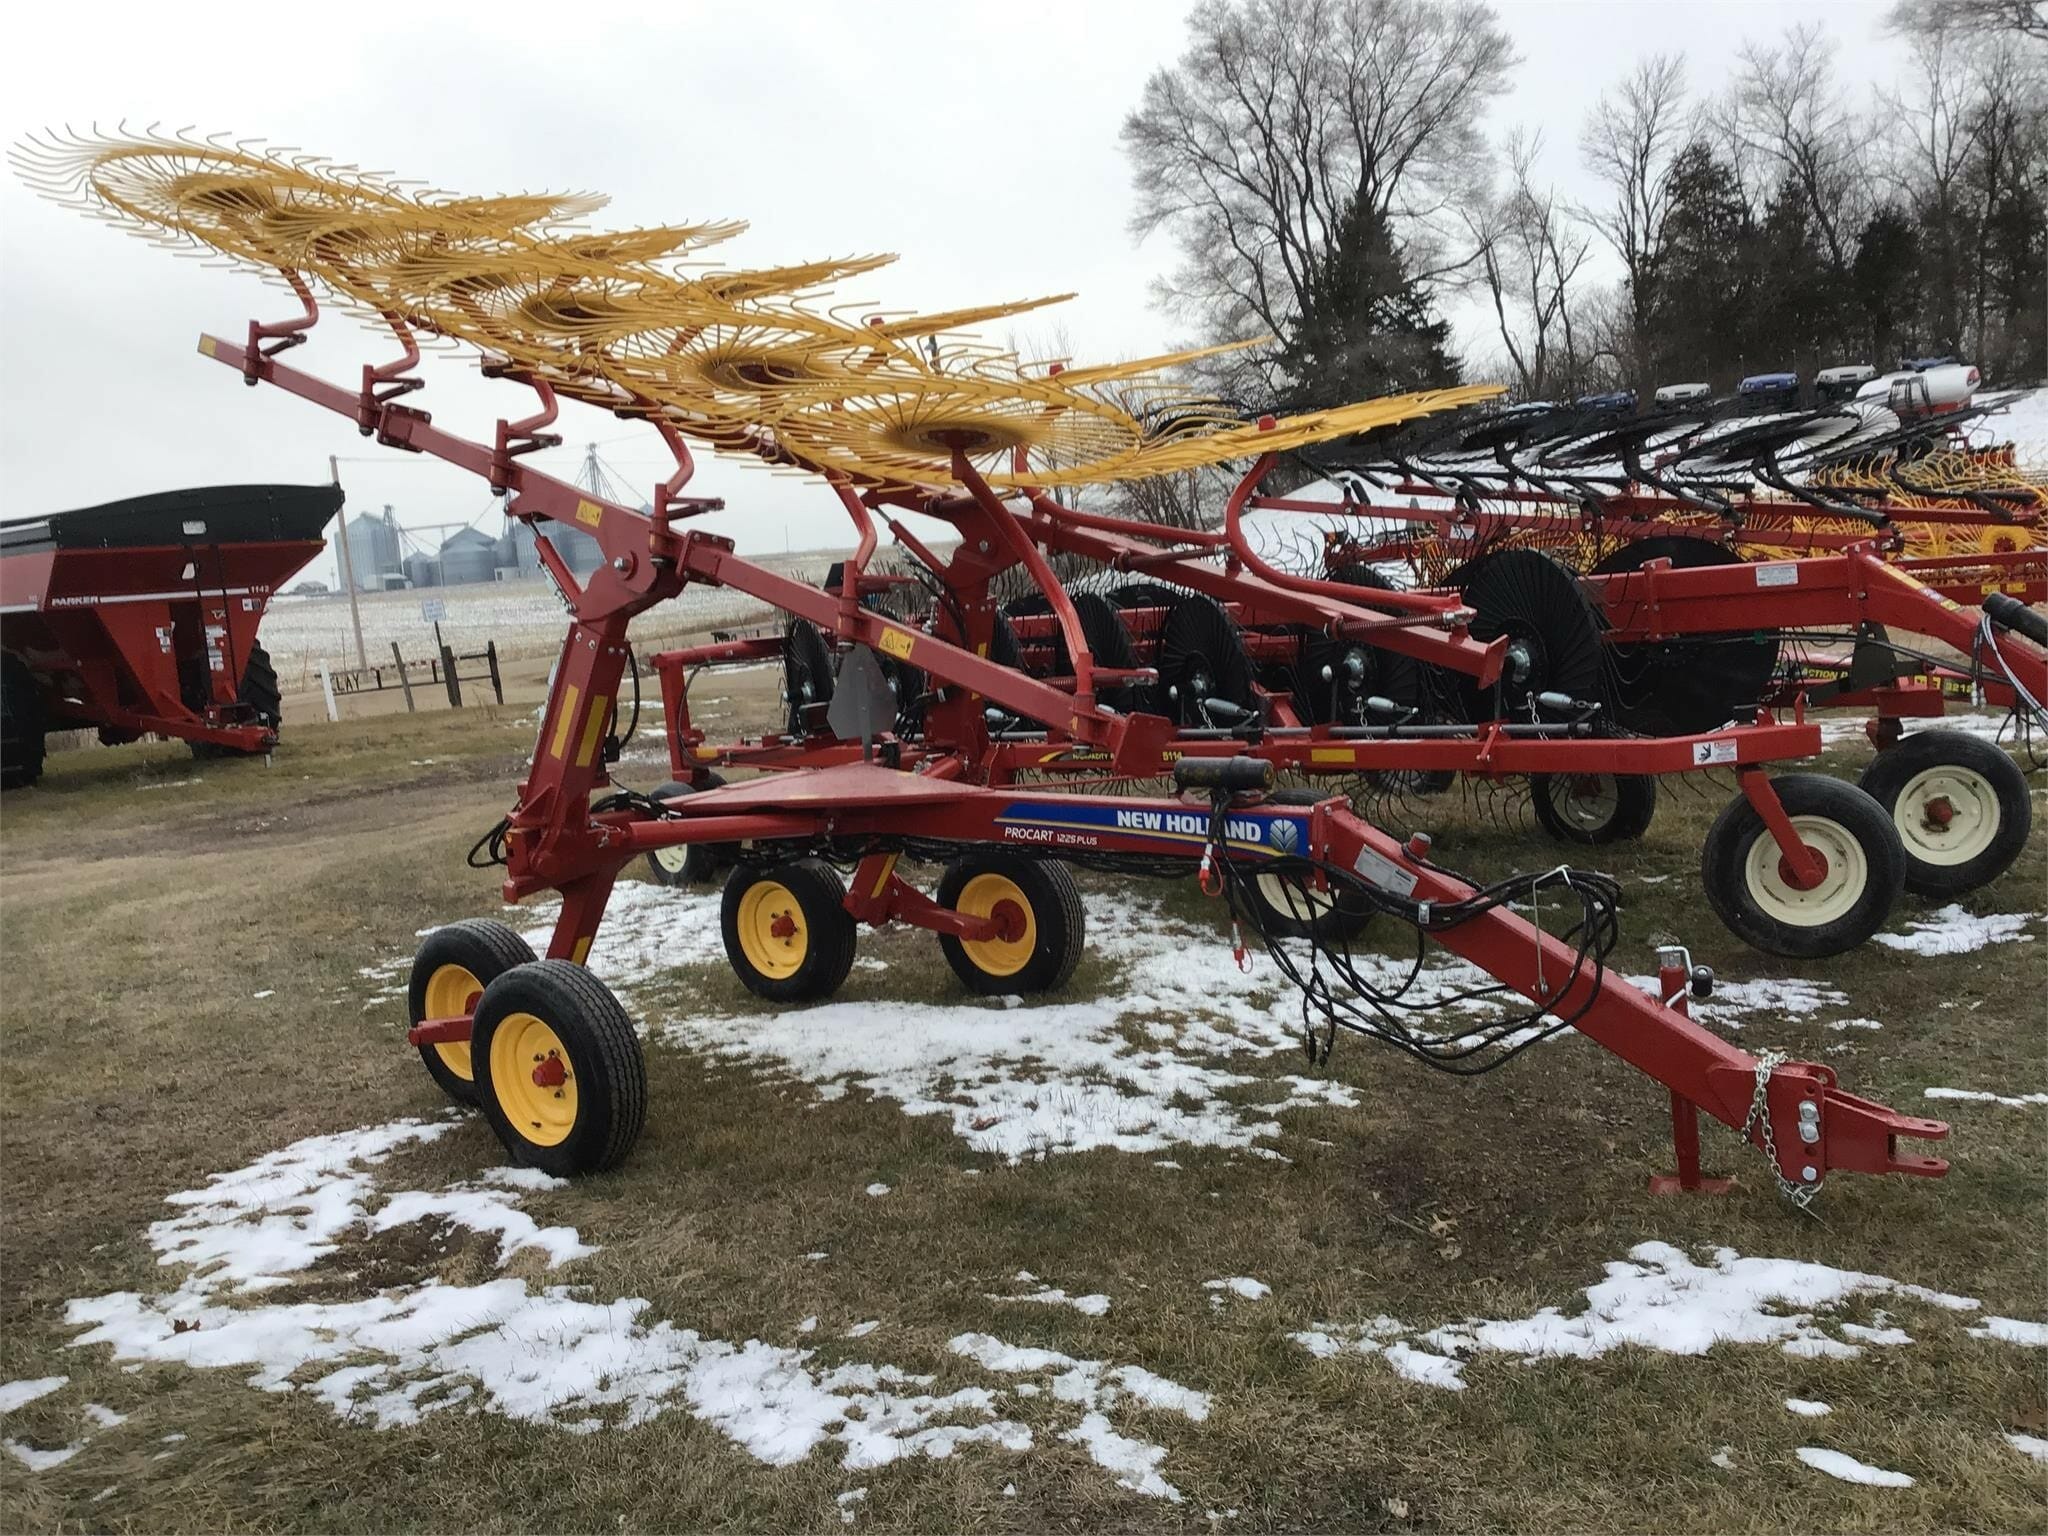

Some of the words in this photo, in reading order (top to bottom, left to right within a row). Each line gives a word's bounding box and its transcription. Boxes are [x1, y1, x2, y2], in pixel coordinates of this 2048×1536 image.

[52, 595, 99, 607] PARKER
[1116, 810, 1162, 829] NEW
[1004, 827, 1055, 842] PROCART
[1057, 833, 1076, 844] 1225
[1077, 836, 1098, 846] PLUS
